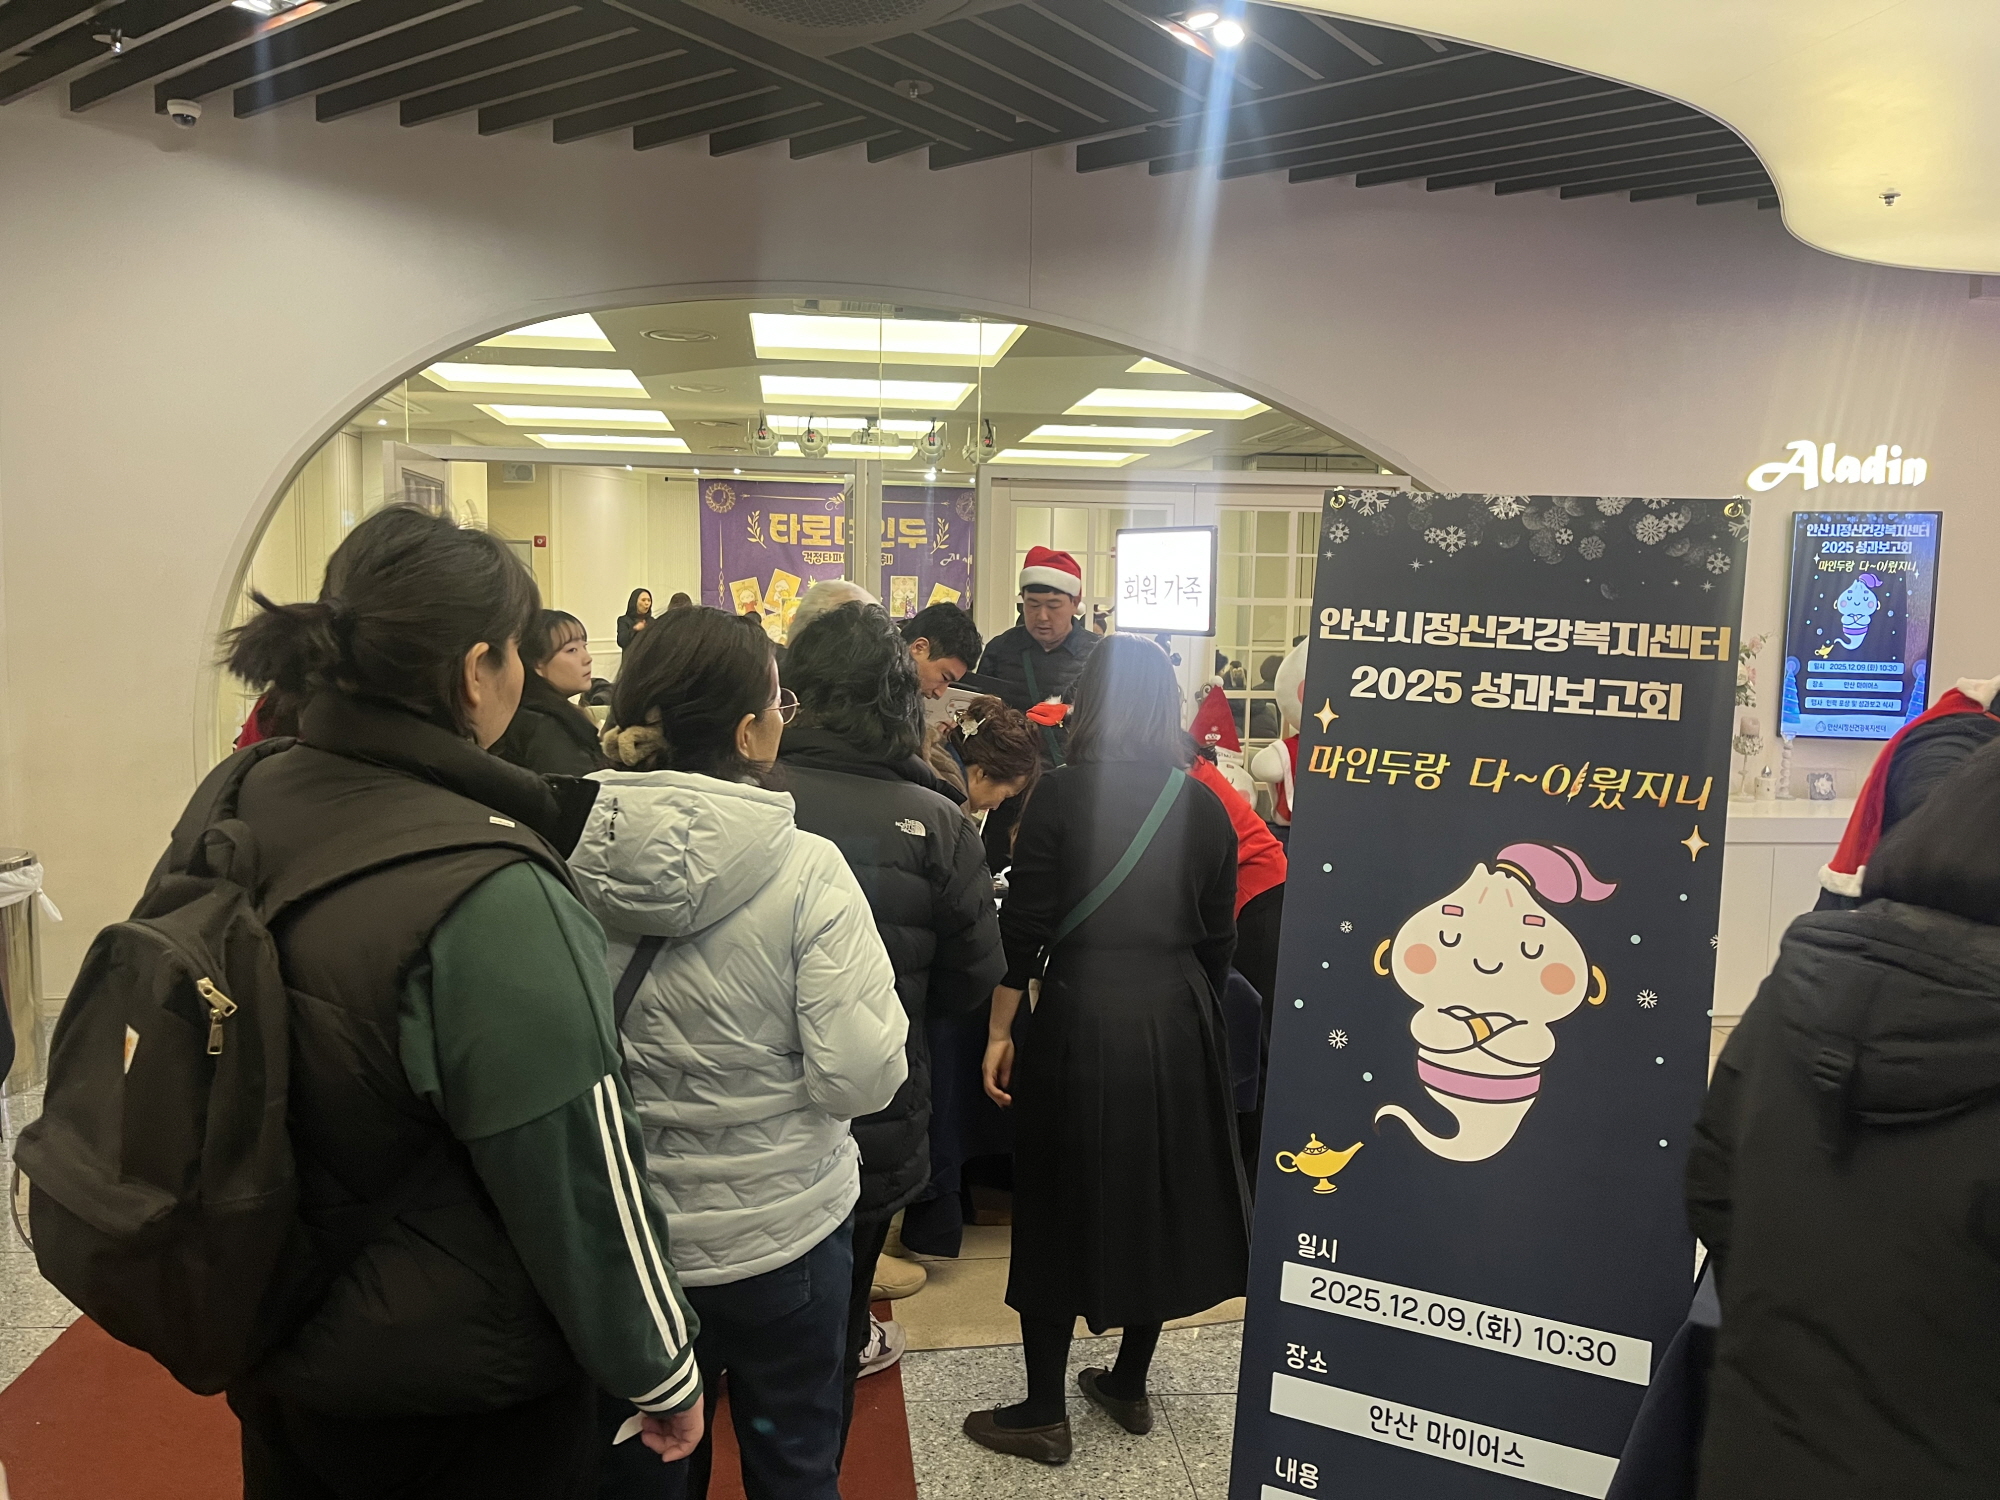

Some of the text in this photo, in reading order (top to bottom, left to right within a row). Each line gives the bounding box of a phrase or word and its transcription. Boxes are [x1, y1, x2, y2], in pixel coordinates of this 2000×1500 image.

[1747, 439, 1928, 492] Aladin
[1807, 523, 1931, 538] 안산시정신건강복지센터
[803, 551, 846, 565] 걱정타파
[1821, 541, 1913, 554] 2025 성과보고회
[1818, 560, 1855, 573] 마인두랑
[1123, 574, 1203, 607] 회원 가족
[1319, 606, 1732, 662] 안산시정신건강복지센터
[1880, 664, 1898, 672] 10:30
[1349, 665, 1684, 722] 2025 성과보고회
[1827, 723, 1887, 733] 안산시정신건강복지센터
[1308, 744, 1714, 812] 마인두랑 다~이뤘지니
[1297, 1232, 1338, 1264] 일시
[1310, 1276, 1617, 1368] 2025.12.09.(화) 10:30
[1285, 1343, 1328, 1374] 장소
[1369, 1404, 1526, 1469] 안산 마이어스
[1275, 1455, 1320, 1490] 내용
